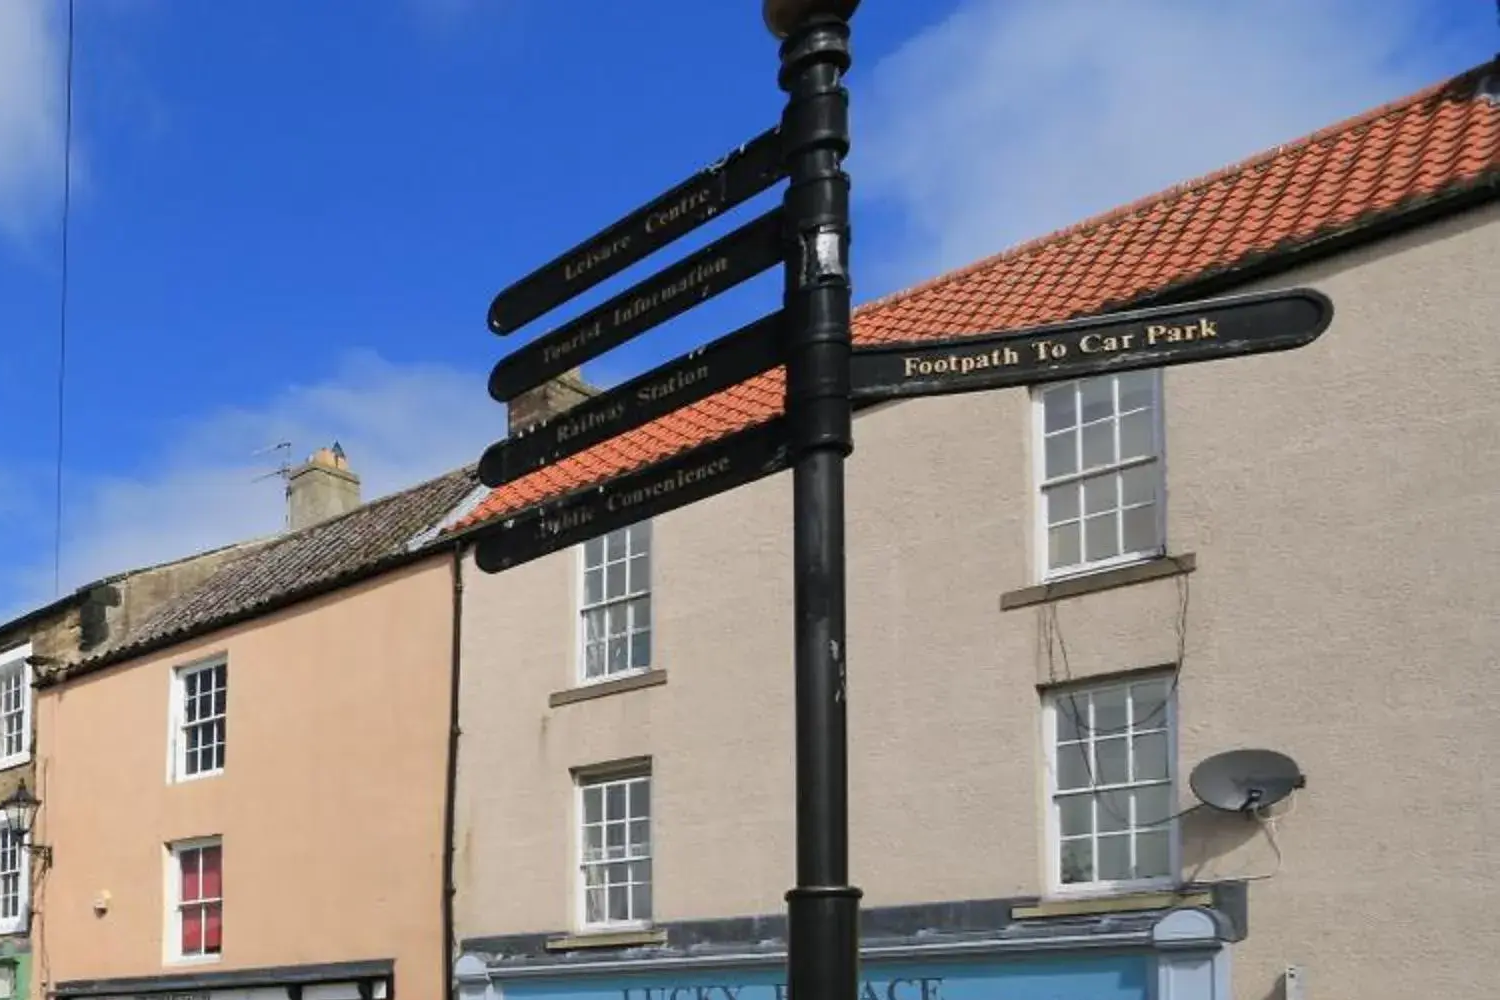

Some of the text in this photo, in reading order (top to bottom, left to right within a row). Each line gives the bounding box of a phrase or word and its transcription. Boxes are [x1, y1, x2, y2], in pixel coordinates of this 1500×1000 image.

[564, 188, 710, 281] Leisure Centre
[542, 256, 729, 364] Tourist Information
[904, 317, 1218, 377] Footpath To Car Park
[556, 364, 710, 444] Railway Station
[607, 455, 731, 513] Convenience
